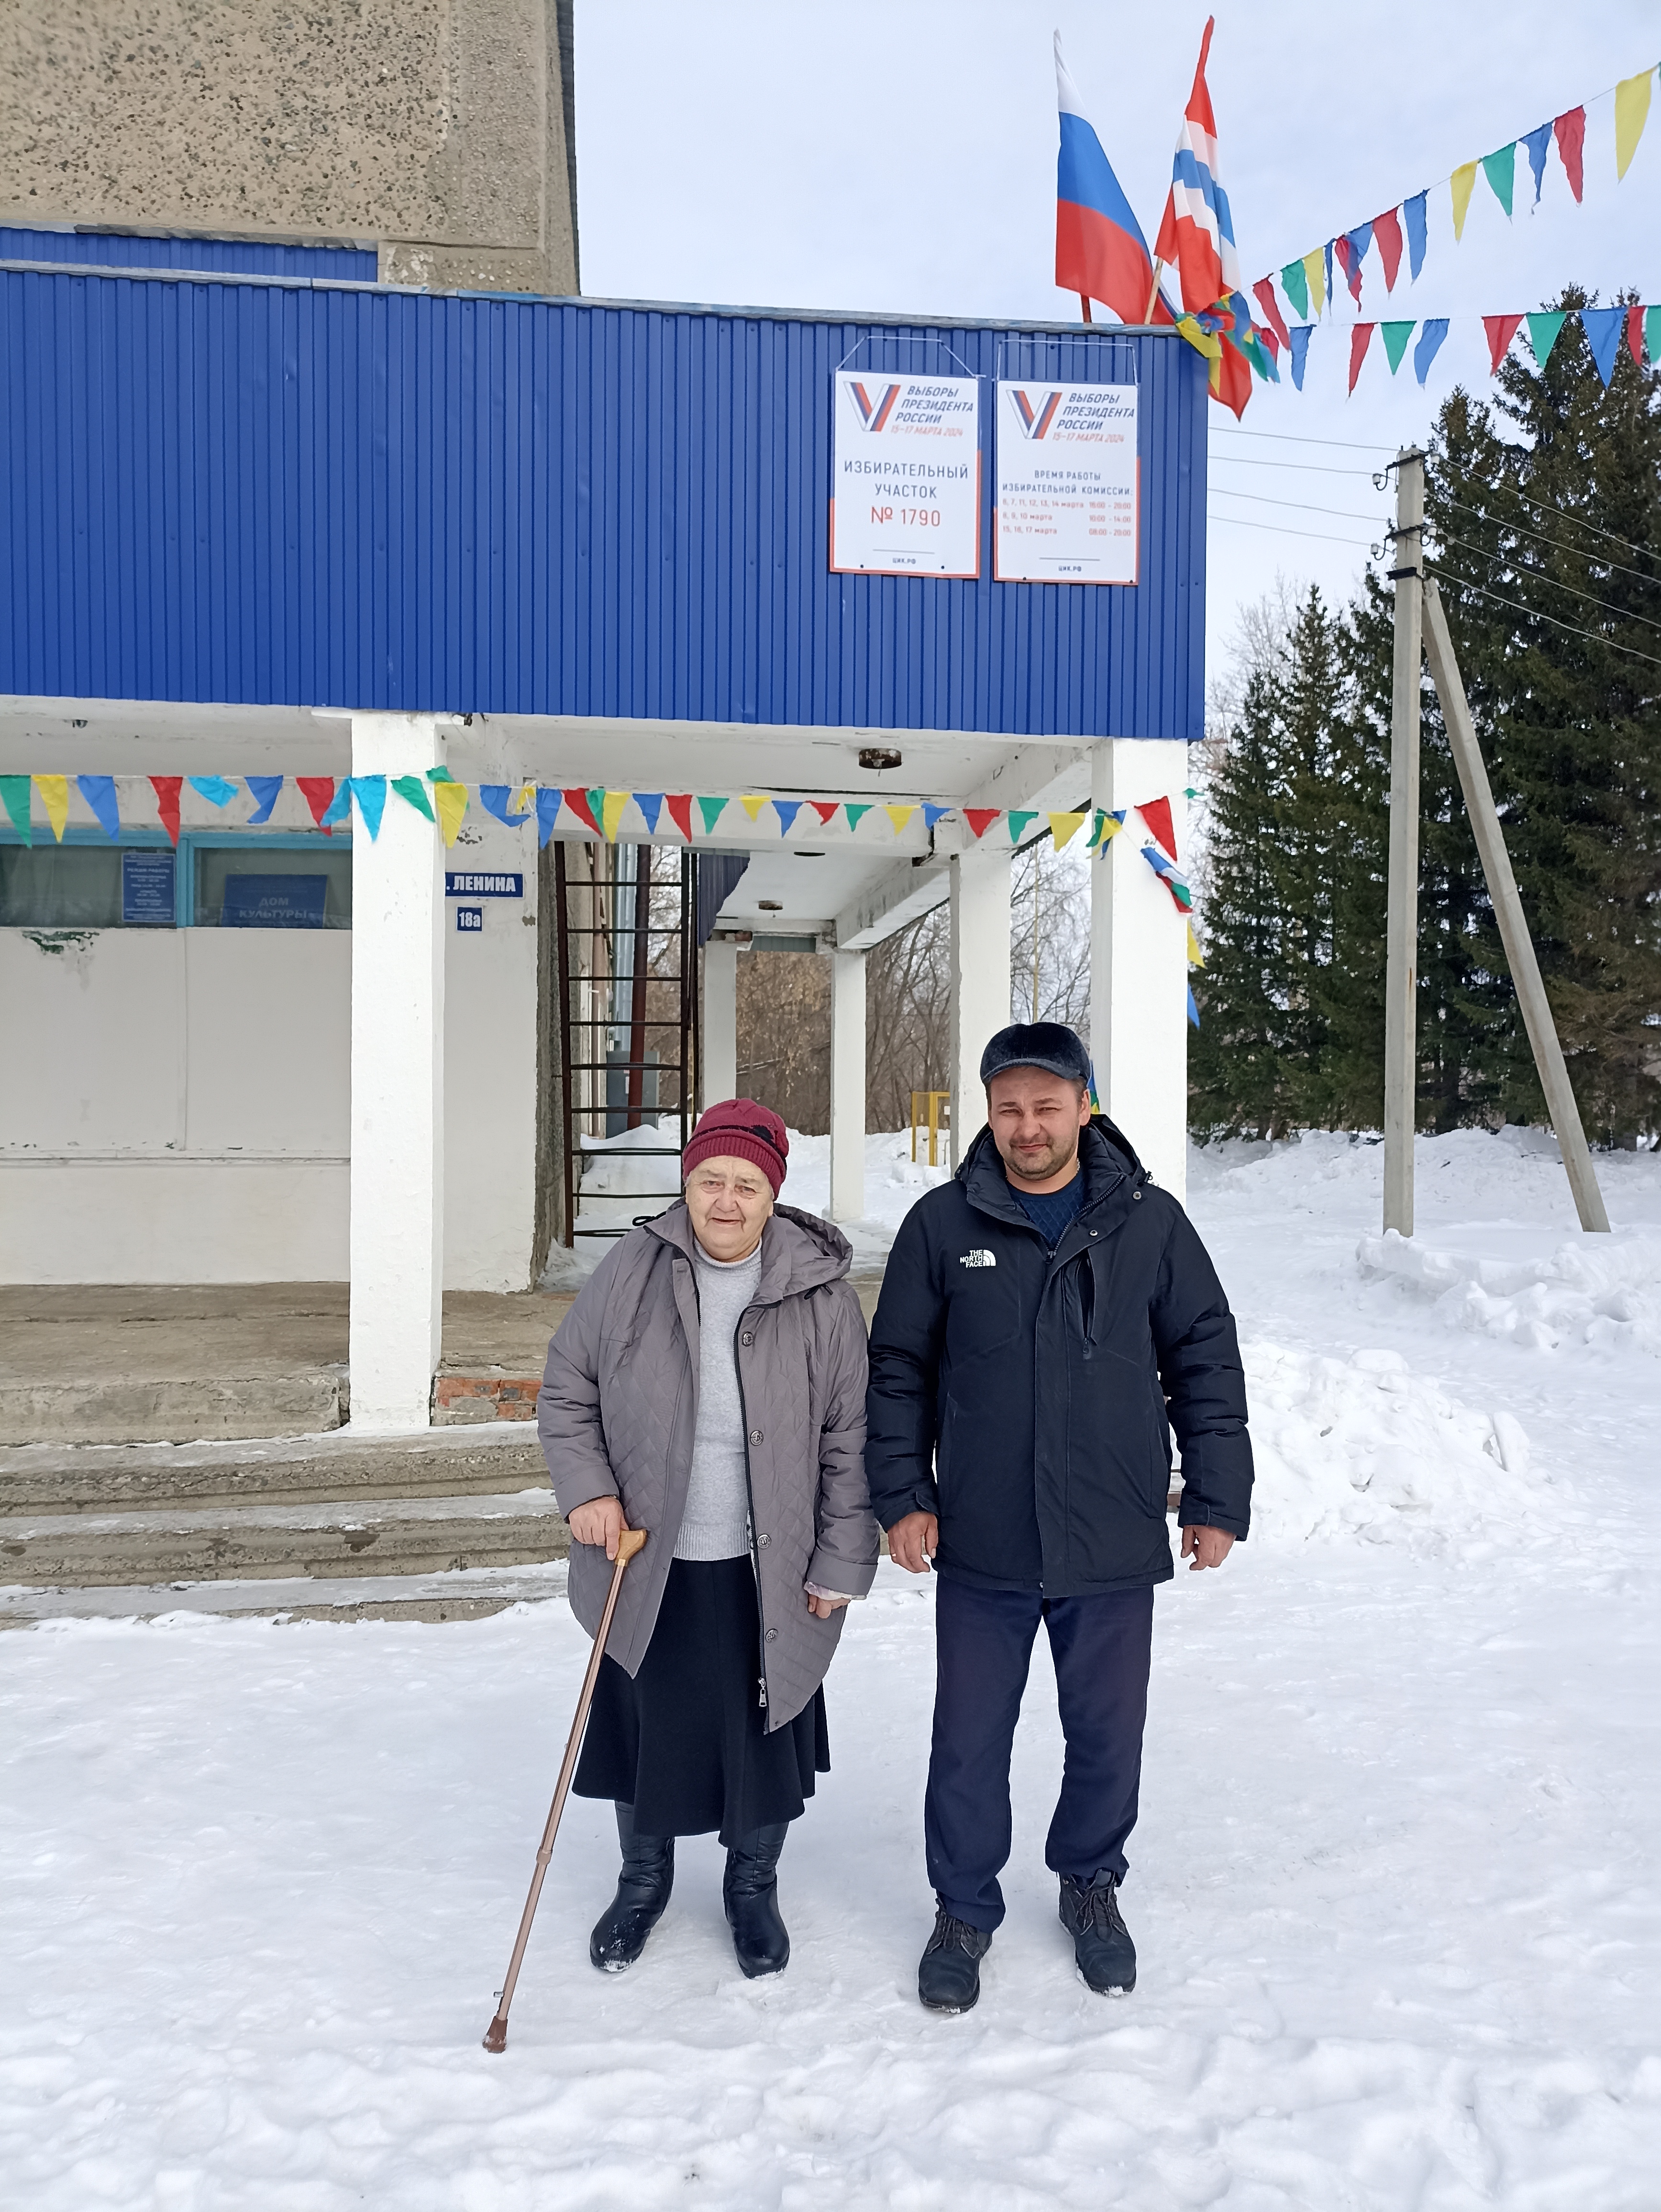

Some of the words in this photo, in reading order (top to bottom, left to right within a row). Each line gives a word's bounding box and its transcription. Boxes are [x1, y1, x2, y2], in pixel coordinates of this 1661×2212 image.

[907, 385, 959, 397] ВЫБОРЫ
[1069, 393, 1120, 404] ВЫБОРЫ
[901, 398, 974, 412] ПРЕЗИДЕНТА
[895, 412, 941, 424] РОССИИ
[1063, 406, 1134, 418] ПРЕЗИДЕНТА
[914, 425, 942, 436] МАРТА
[1057, 420, 1104, 431] РОССИИ
[1075, 433, 1103, 442] МАРТА
[844, 460, 968, 479] ИЗБИРАТЕЛЬНЫЙ
[1034, 470, 1063, 479] ВРЕМЯ
[1066, 471, 1101, 481] РАБОТЫ
[875, 483, 937, 498] УЧАСТОК
[1002, 483, 1076, 494] ИЗБИРАТЕЛЬНОЙ
[1082, 486, 1133, 496] КОМИССИИ:
[871, 506, 893, 524] №
[901, 509, 941, 527] 1790
[453, 875, 516, 892] ЛЕНИНА
[258, 897, 289, 907] ДОМ
[239, 909, 307, 918] КУЛЬТУРЫ
[459, 912, 480, 927] 18а
[960, 1255, 983, 1263] NORTH
